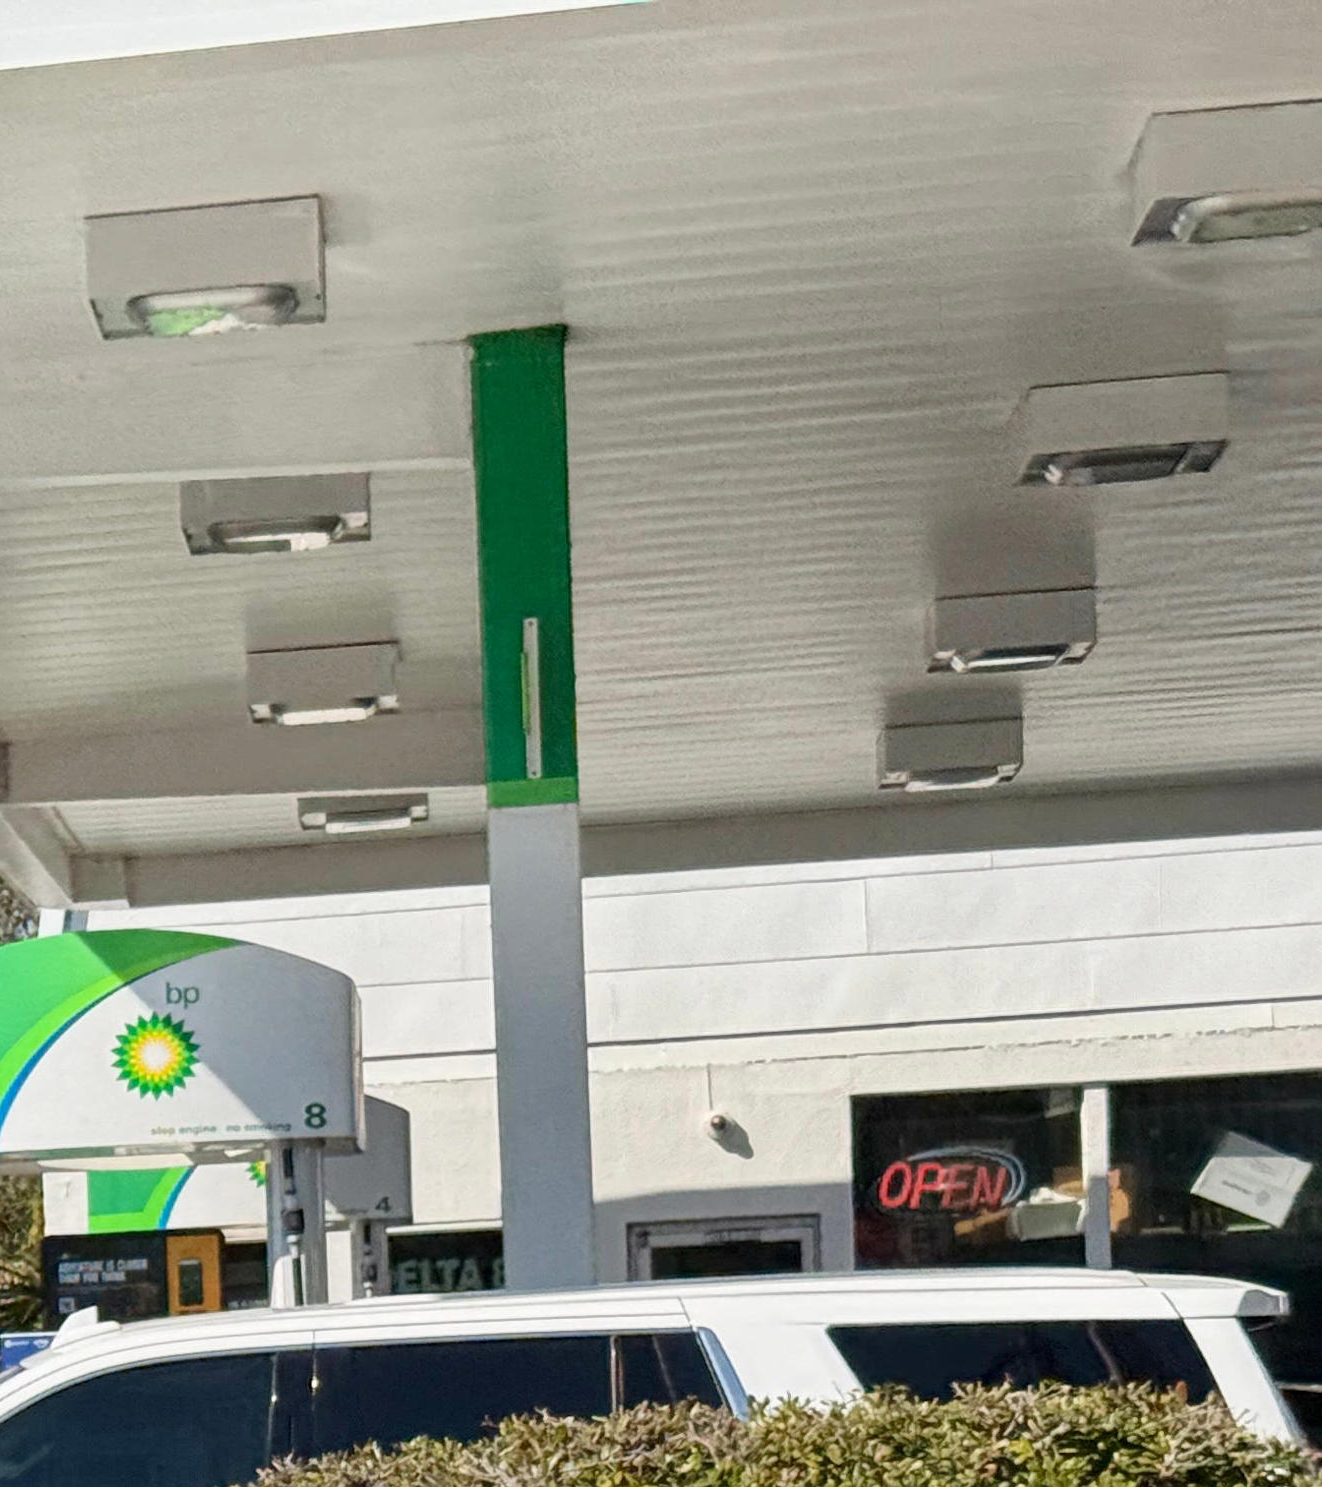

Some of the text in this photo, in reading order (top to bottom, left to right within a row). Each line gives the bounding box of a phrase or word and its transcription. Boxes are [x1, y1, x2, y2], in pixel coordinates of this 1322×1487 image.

[165, 982, 200, 1009] bp
[178, 1125, 217, 1134] engine
[244, 1122, 292, 1132] smoking
[304, 1102, 327, 1129] 8
[879, 1160, 1006, 1209] OPEN
[375, 1196, 391, 1212] 4
[393, 1256, 484, 1294] ELTA
